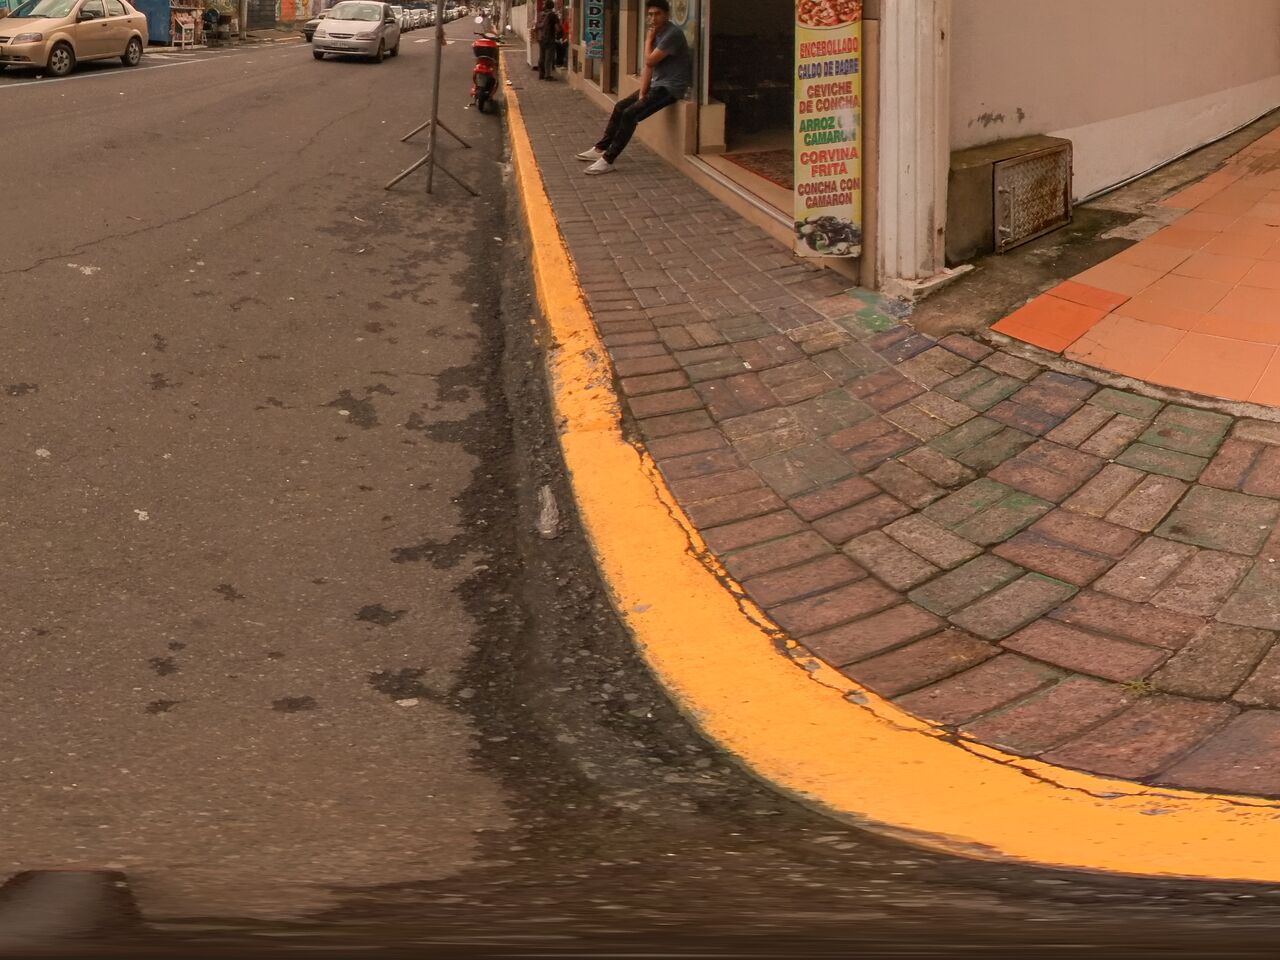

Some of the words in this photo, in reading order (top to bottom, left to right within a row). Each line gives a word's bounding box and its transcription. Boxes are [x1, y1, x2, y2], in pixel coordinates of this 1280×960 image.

[799, 37, 858, 58] ENCEBOLLADO
[798, 62, 822, 80] CALDO
[823, 61, 834, 77] DE
[806, 81, 853, 98] CEVICHE
[799, 100, 814, 114] DE
[815, 95, 860, 112] CONCHA
[799, 116, 836, 133] ARROZ
[800, 147, 859, 165] CORVINA
[811, 162, 848, 177] FRITA
[797, 181, 838, 196] CONCHA
[840, 178, 861, 192] CON
[805, 192, 853, 209] CAMARON
